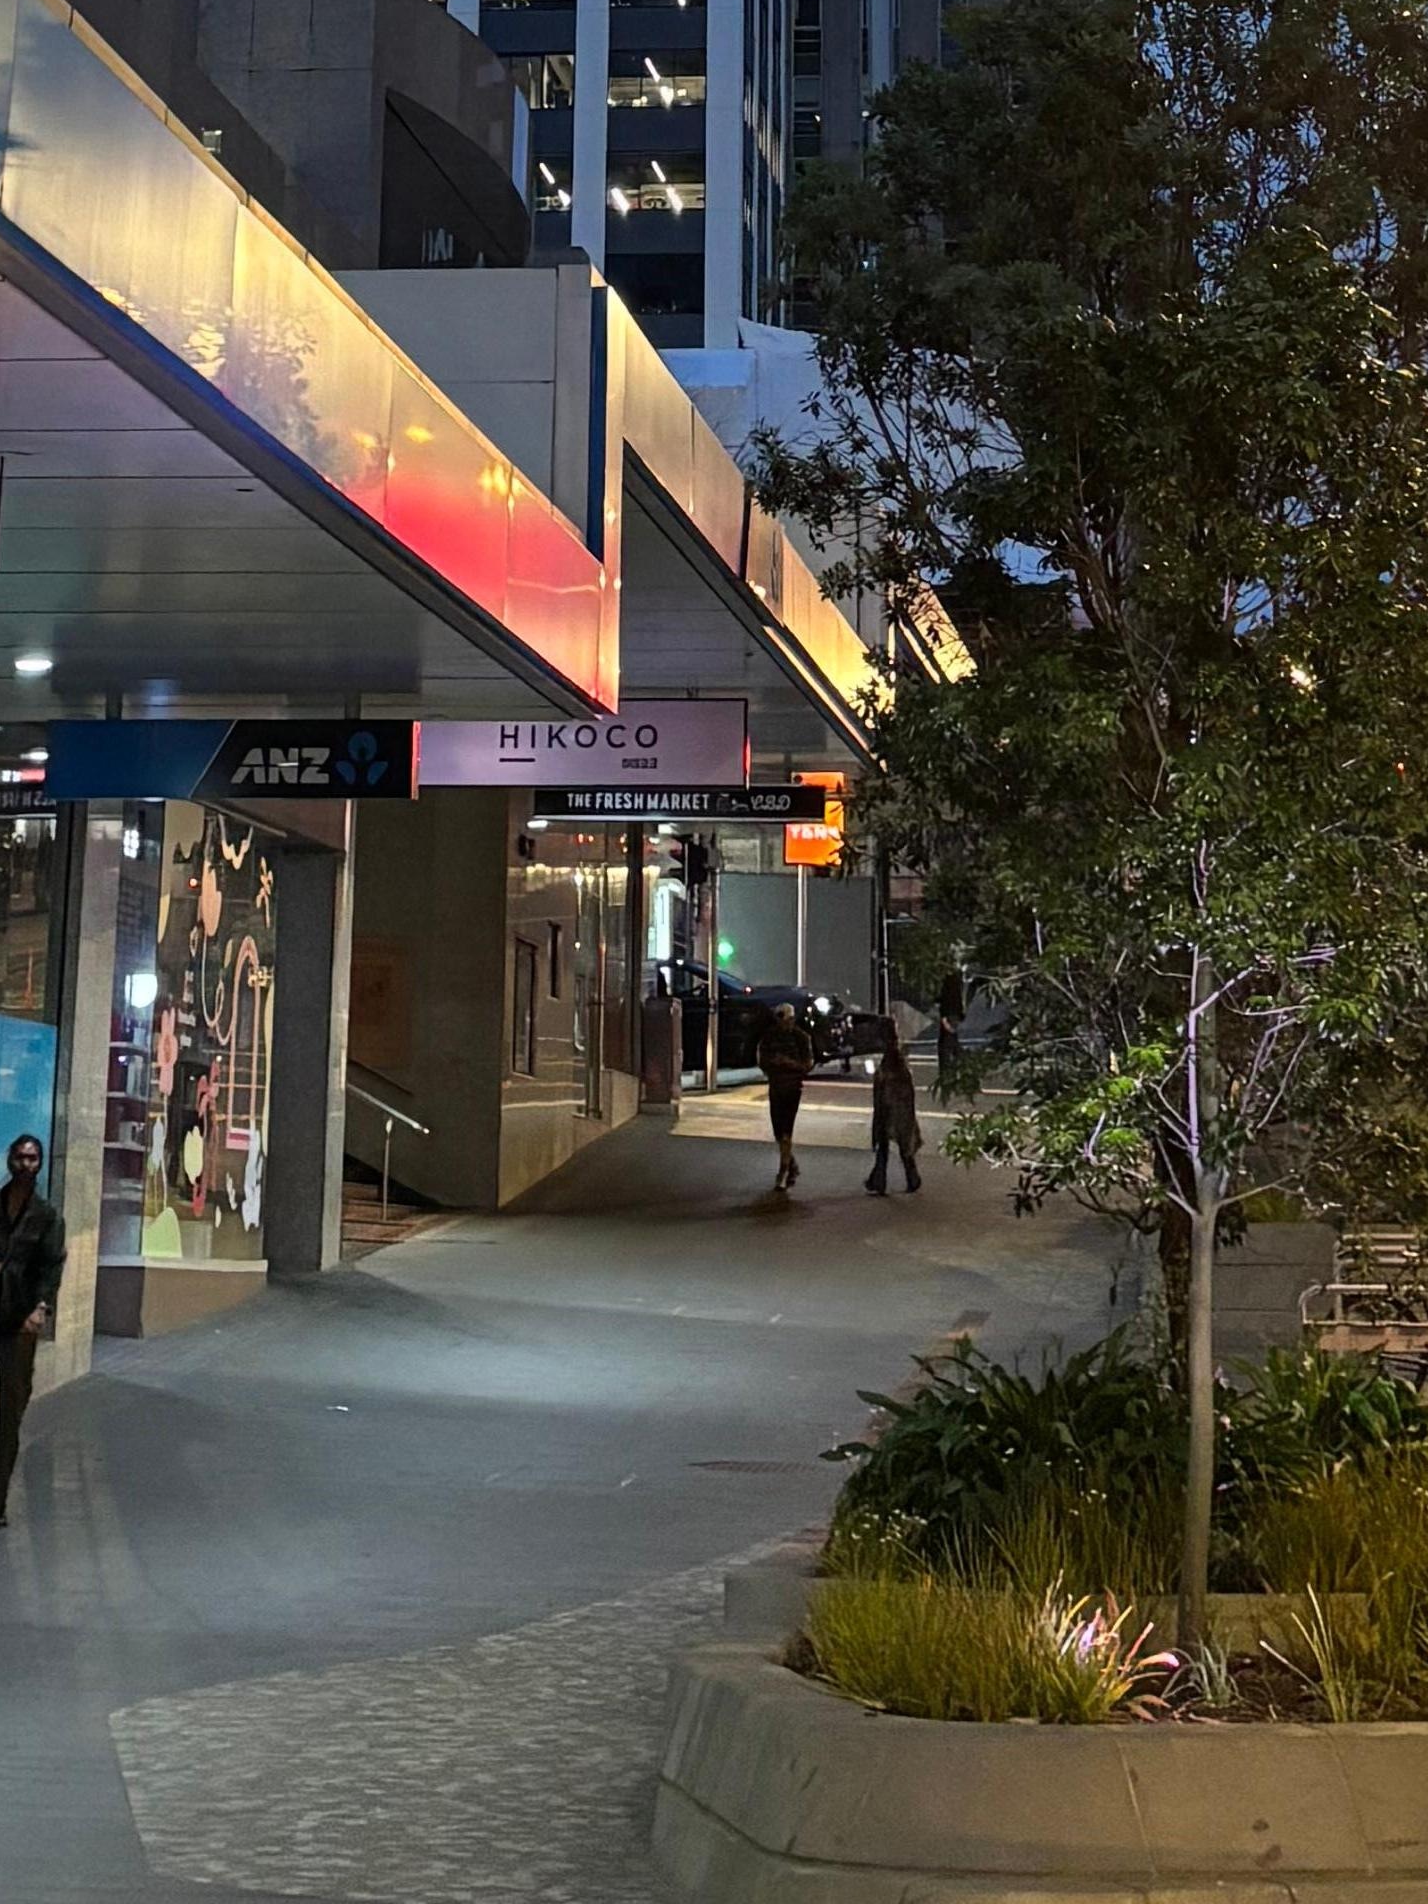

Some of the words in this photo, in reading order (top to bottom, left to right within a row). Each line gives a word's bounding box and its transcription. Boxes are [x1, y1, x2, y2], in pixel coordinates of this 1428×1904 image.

[499, 724, 659, 749] HIKOCO
[230, 747, 330, 785] ANZ
[567, 794, 591, 808] THE
[595, 792, 644, 810] FRESH
[646, 792, 710, 810] MARKET
